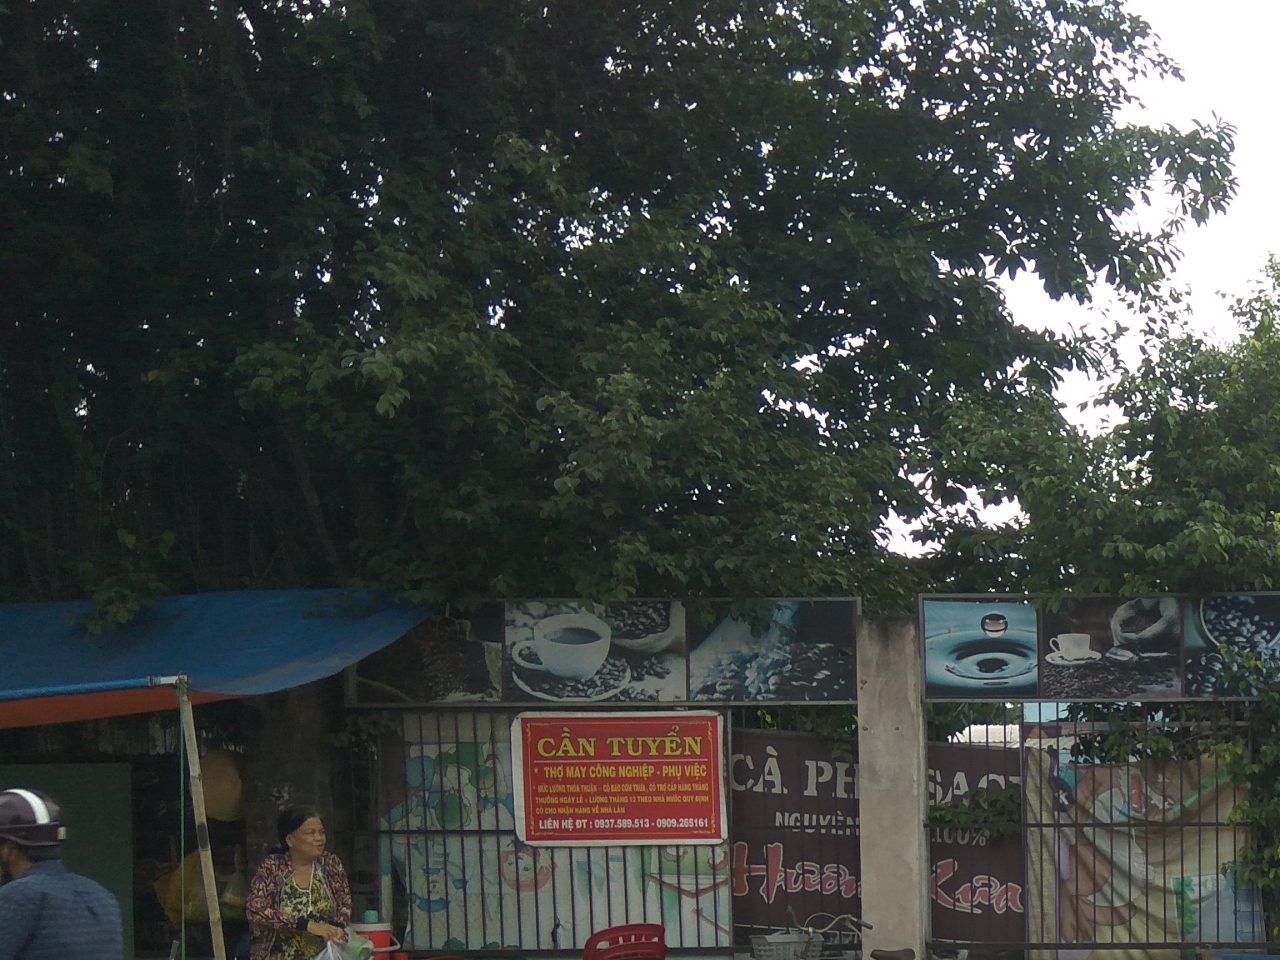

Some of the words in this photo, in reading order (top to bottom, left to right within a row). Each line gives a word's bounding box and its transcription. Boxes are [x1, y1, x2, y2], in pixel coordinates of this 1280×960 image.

[537, 726, 597, 757] CẦN
[606, 725, 703, 756] TUYỂN
[544, 765, 564, 782] THỢ
[566, 766, 587, 778] MAY
[589, 763, 617, 778] CÔNG
[618, 762, 655, 781] NGHIỆP
[662, 765, 682, 780] PHỤ
[684, 762, 707, 780] VIỆC
[731, 745, 788, 795] CÀ
[539, 817, 560, 830] LIÊN
[561, 817, 574, 832] HỆ
[575, 819, 588, 830] ĐT
